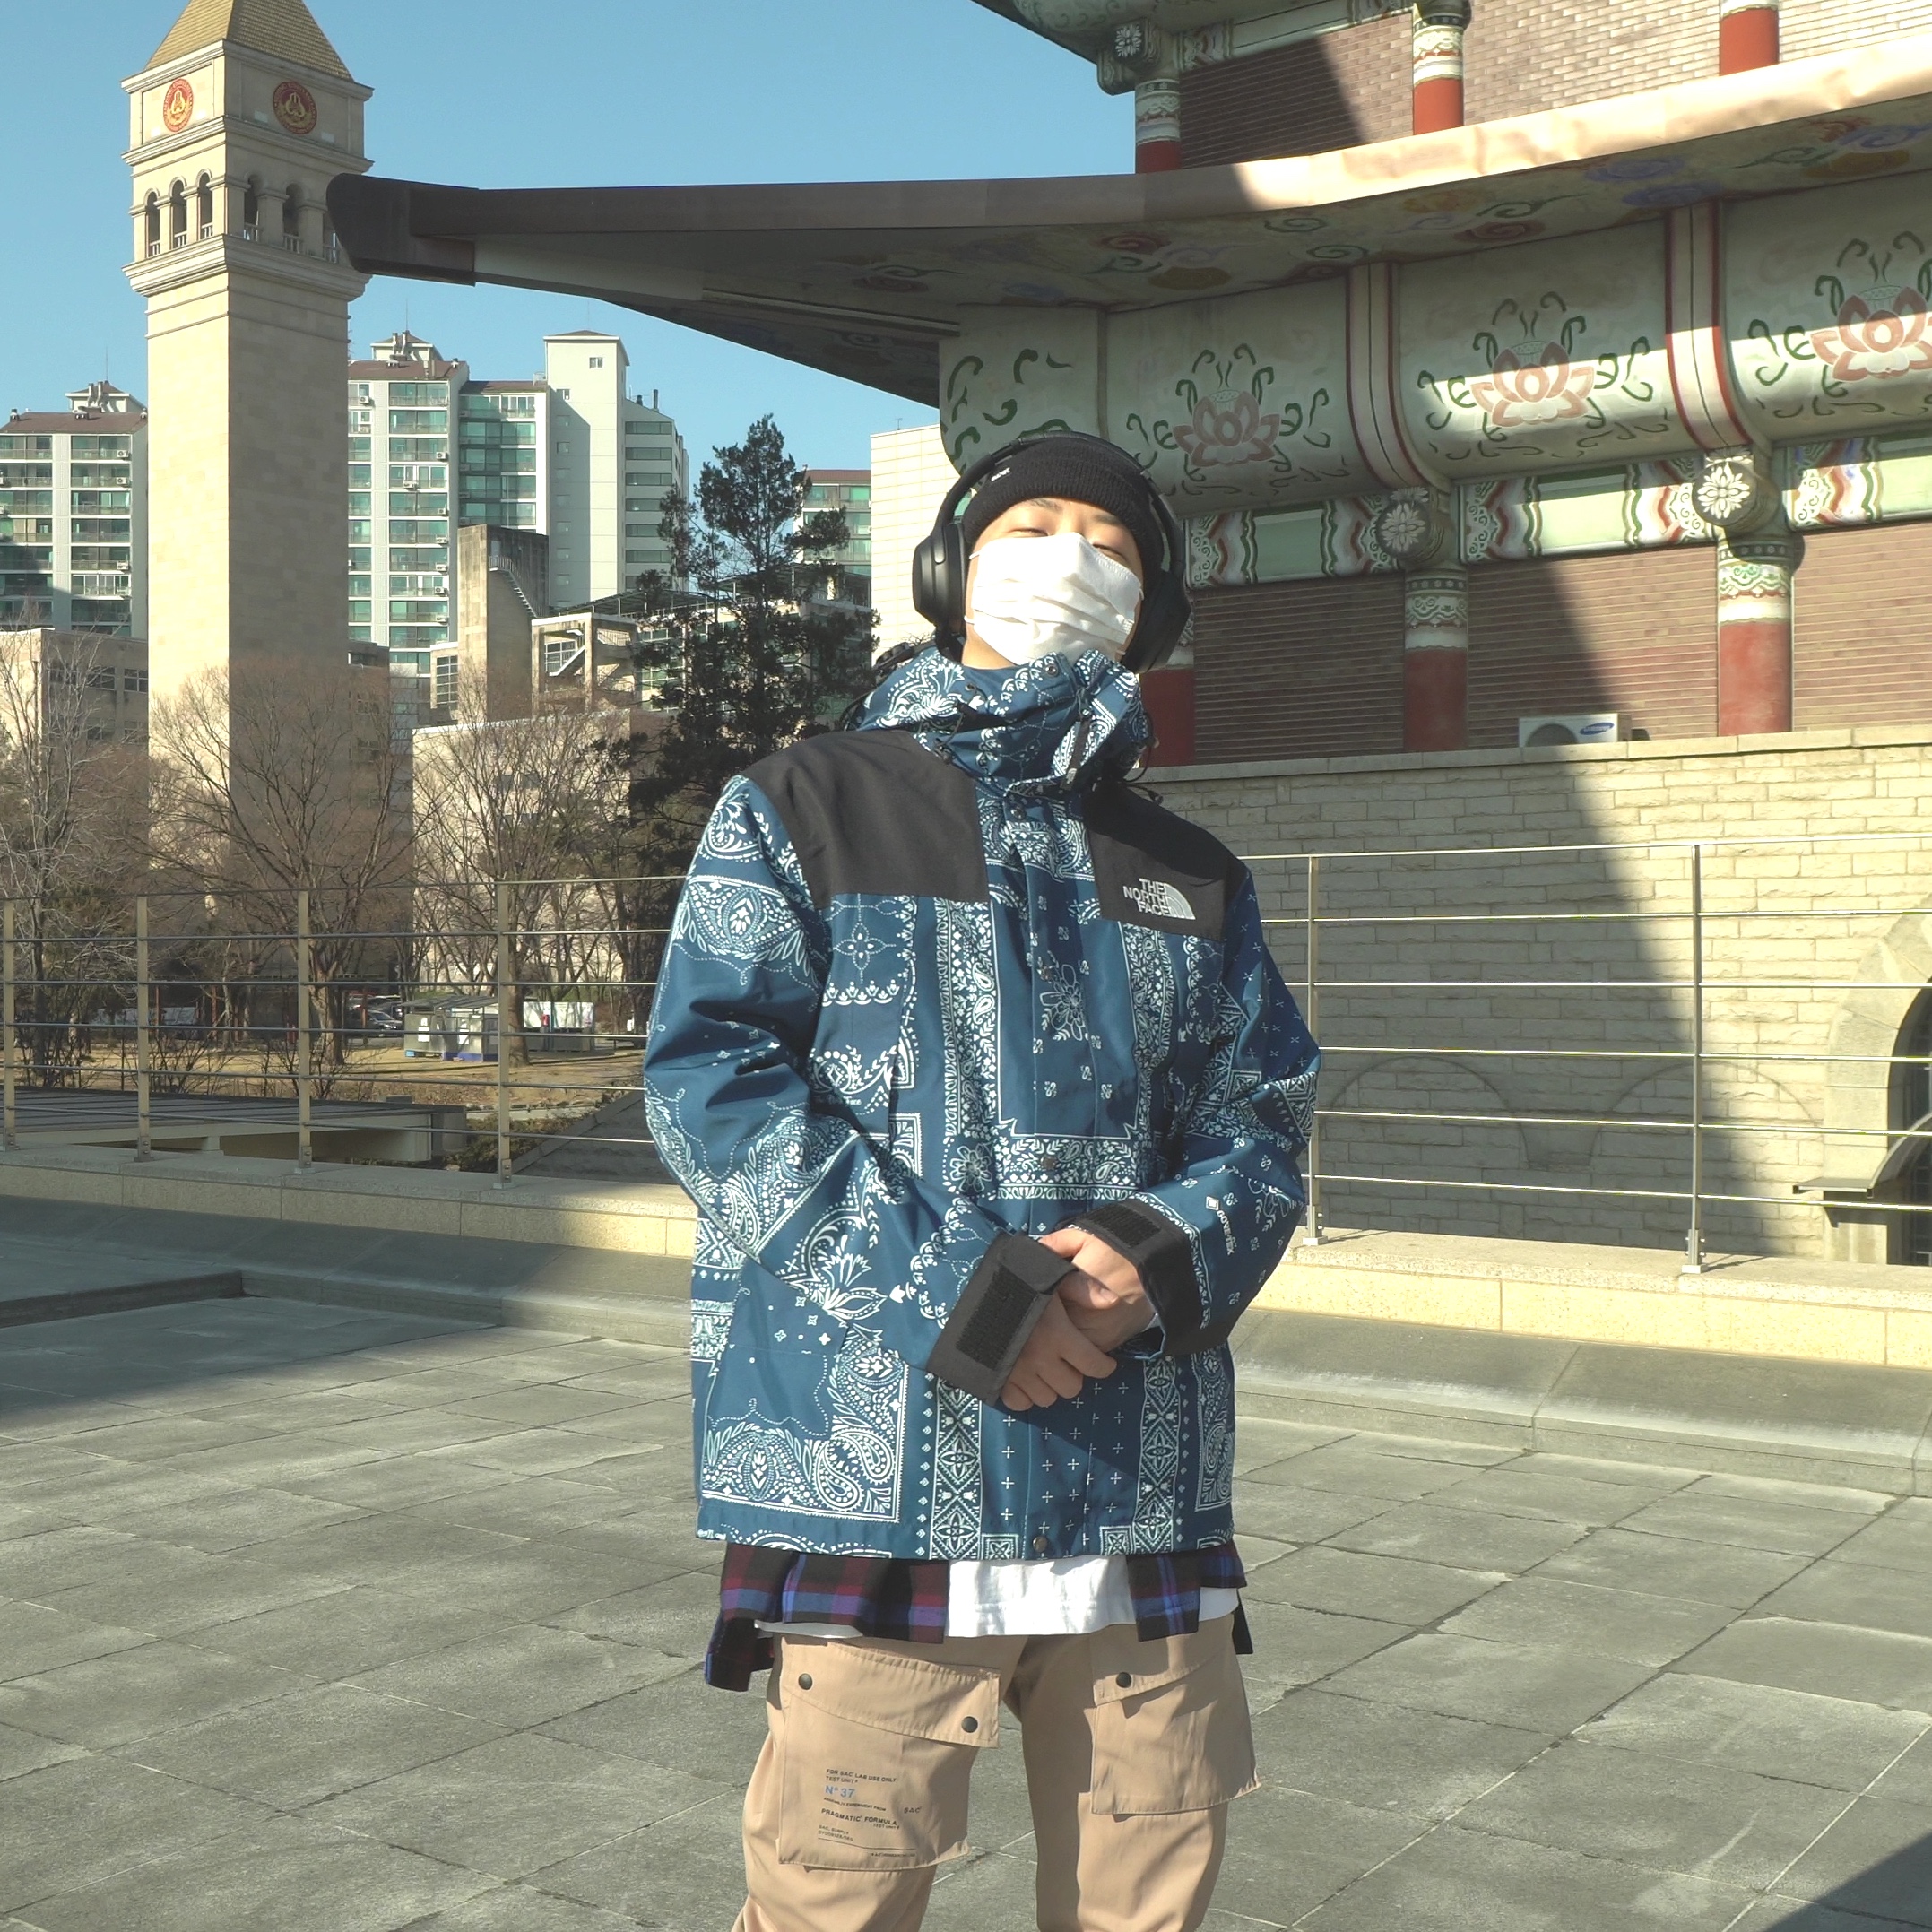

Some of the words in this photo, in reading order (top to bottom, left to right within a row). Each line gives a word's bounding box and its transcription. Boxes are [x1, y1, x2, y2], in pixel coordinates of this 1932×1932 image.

[1139, 878, 1166, 895] THE
[1122, 886, 1166, 905] NORTH
[1137, 900, 1171, 916] FACE
[840, 1788, 855, 1798] 37
[864, 1816, 897, 1826] FORMULA
